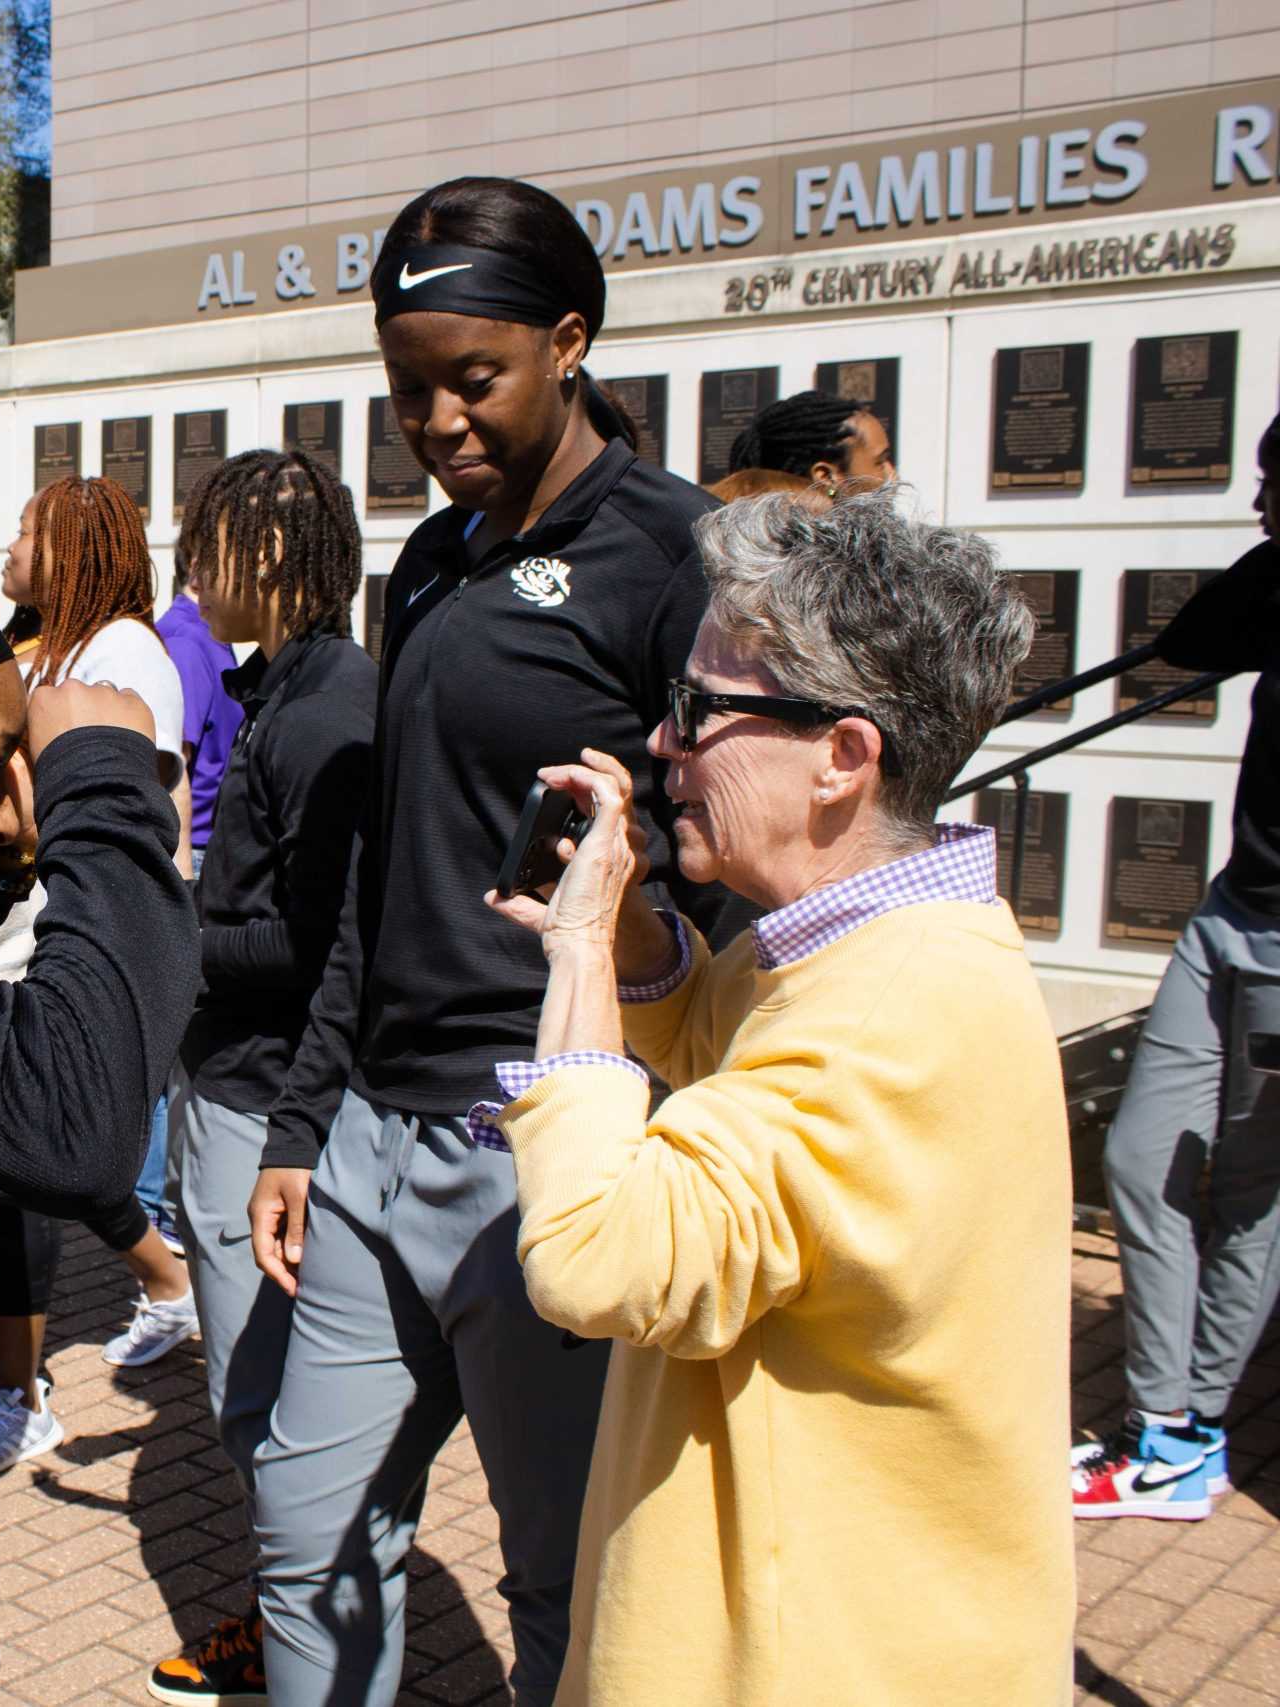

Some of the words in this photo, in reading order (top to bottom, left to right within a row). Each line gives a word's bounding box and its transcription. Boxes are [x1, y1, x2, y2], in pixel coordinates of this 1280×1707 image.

[198, 250, 256, 311] AL
[275, 244, 317, 300] &
[336, 228, 388, 294] B
[573, 175, 763, 261] DAMS
[794, 119, 1148, 239] FAMILIES
[1213, 104, 1280, 190] R
[802, 255, 944, 306] CENTURY
[950, 223, 1237, 293] ALL-AMERICANS
